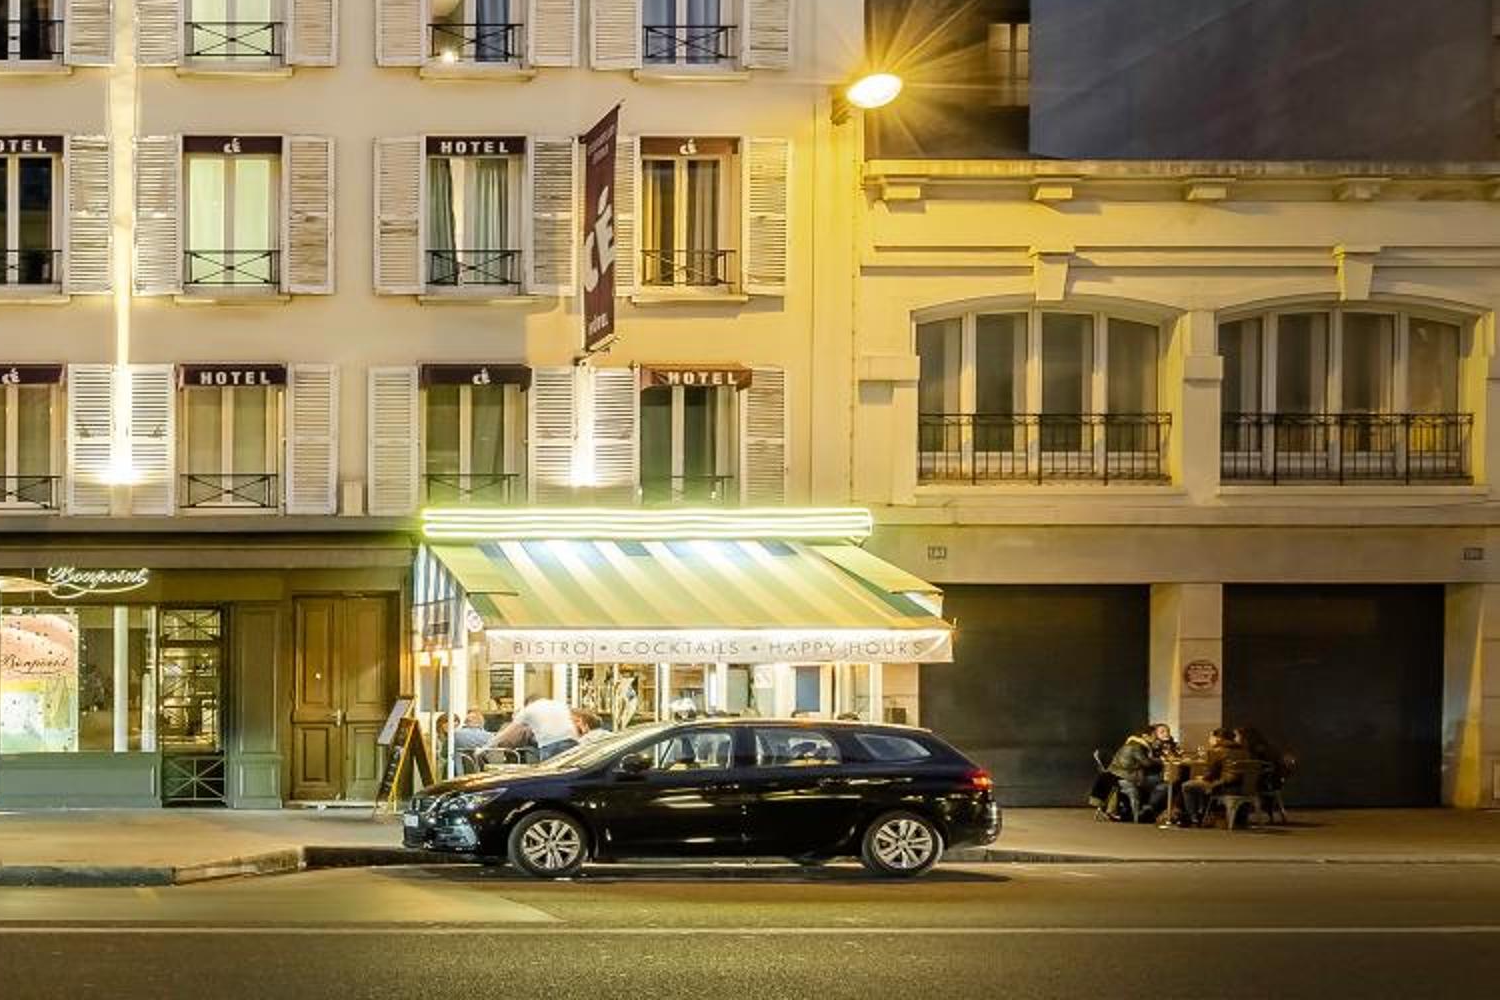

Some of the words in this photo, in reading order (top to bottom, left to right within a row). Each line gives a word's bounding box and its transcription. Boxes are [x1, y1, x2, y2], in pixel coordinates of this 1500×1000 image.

[441, 141, 510, 154] HOTEL
[200, 371, 271, 385] HOTEL
[668, 370, 737, 385] HOTEL
[514, 641, 588, 655] BISTRO
[618, 641, 739, 655] COCKTAILS
[770, 641, 836, 655] HAPPY
[850, 641, 923, 655] HOURS
